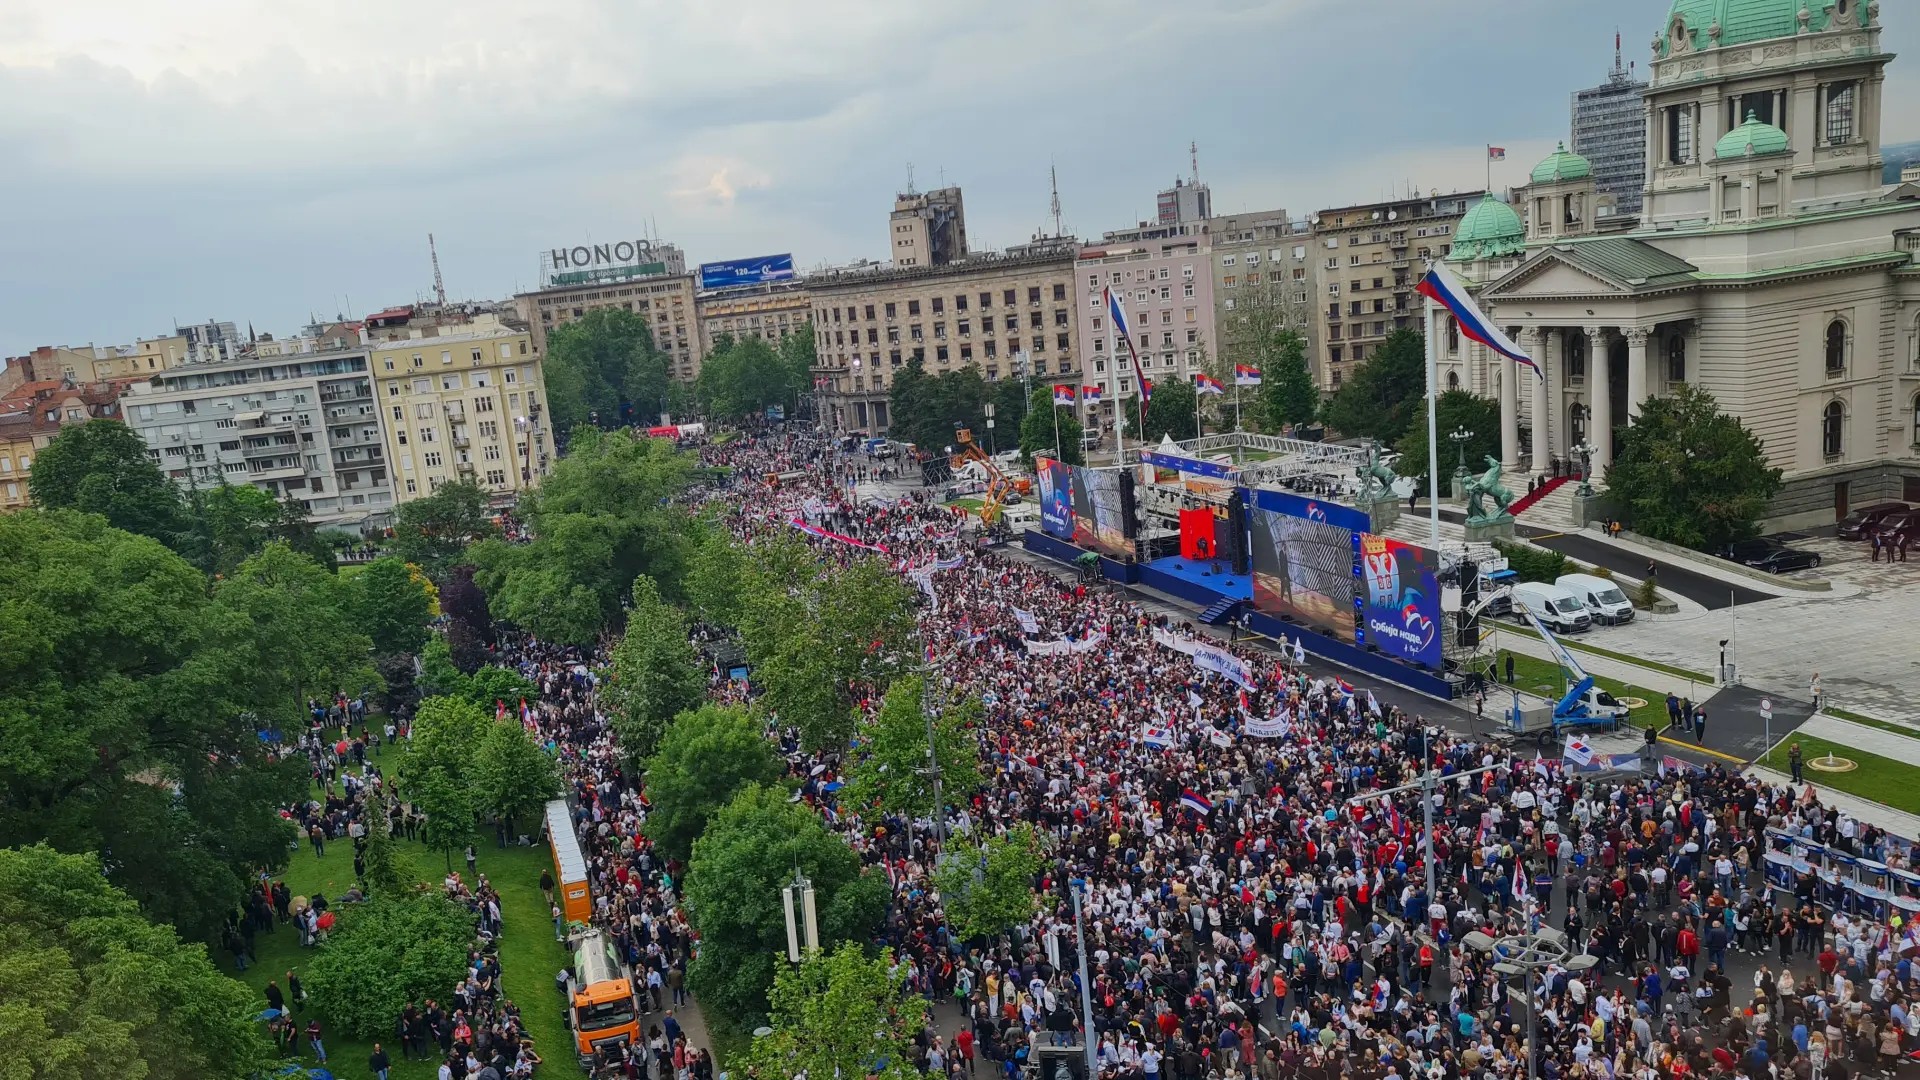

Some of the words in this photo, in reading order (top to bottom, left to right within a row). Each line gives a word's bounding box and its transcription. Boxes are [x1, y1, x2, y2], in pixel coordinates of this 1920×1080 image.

[552, 239, 653, 269] HONOR
[735, 267, 749, 276] 120
[1371, 619, 1399, 637] Србија
[1400, 630, 1422, 645] наде.
